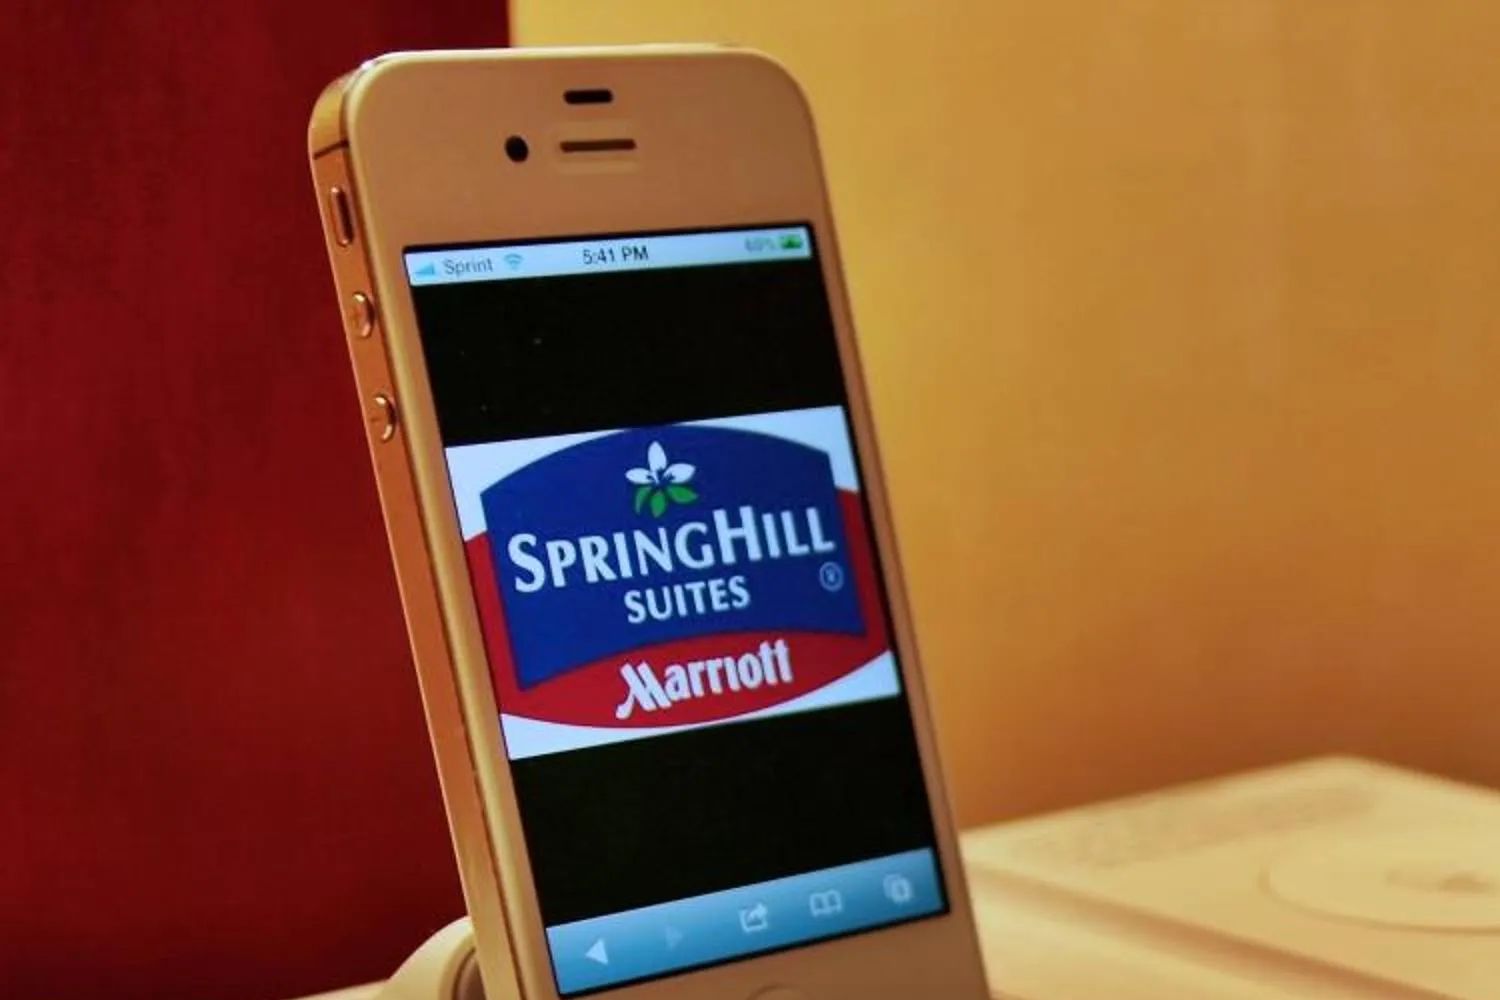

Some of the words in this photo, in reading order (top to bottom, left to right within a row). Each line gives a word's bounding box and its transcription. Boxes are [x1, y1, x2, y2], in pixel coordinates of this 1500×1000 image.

[443, 257, 494, 276] Sprint
[582, 249, 616, 265] 5:41
[621, 245, 650, 262] PM
[623, 575, 751, 624] SUITES
[615, 639, 794, 720] Marriott
